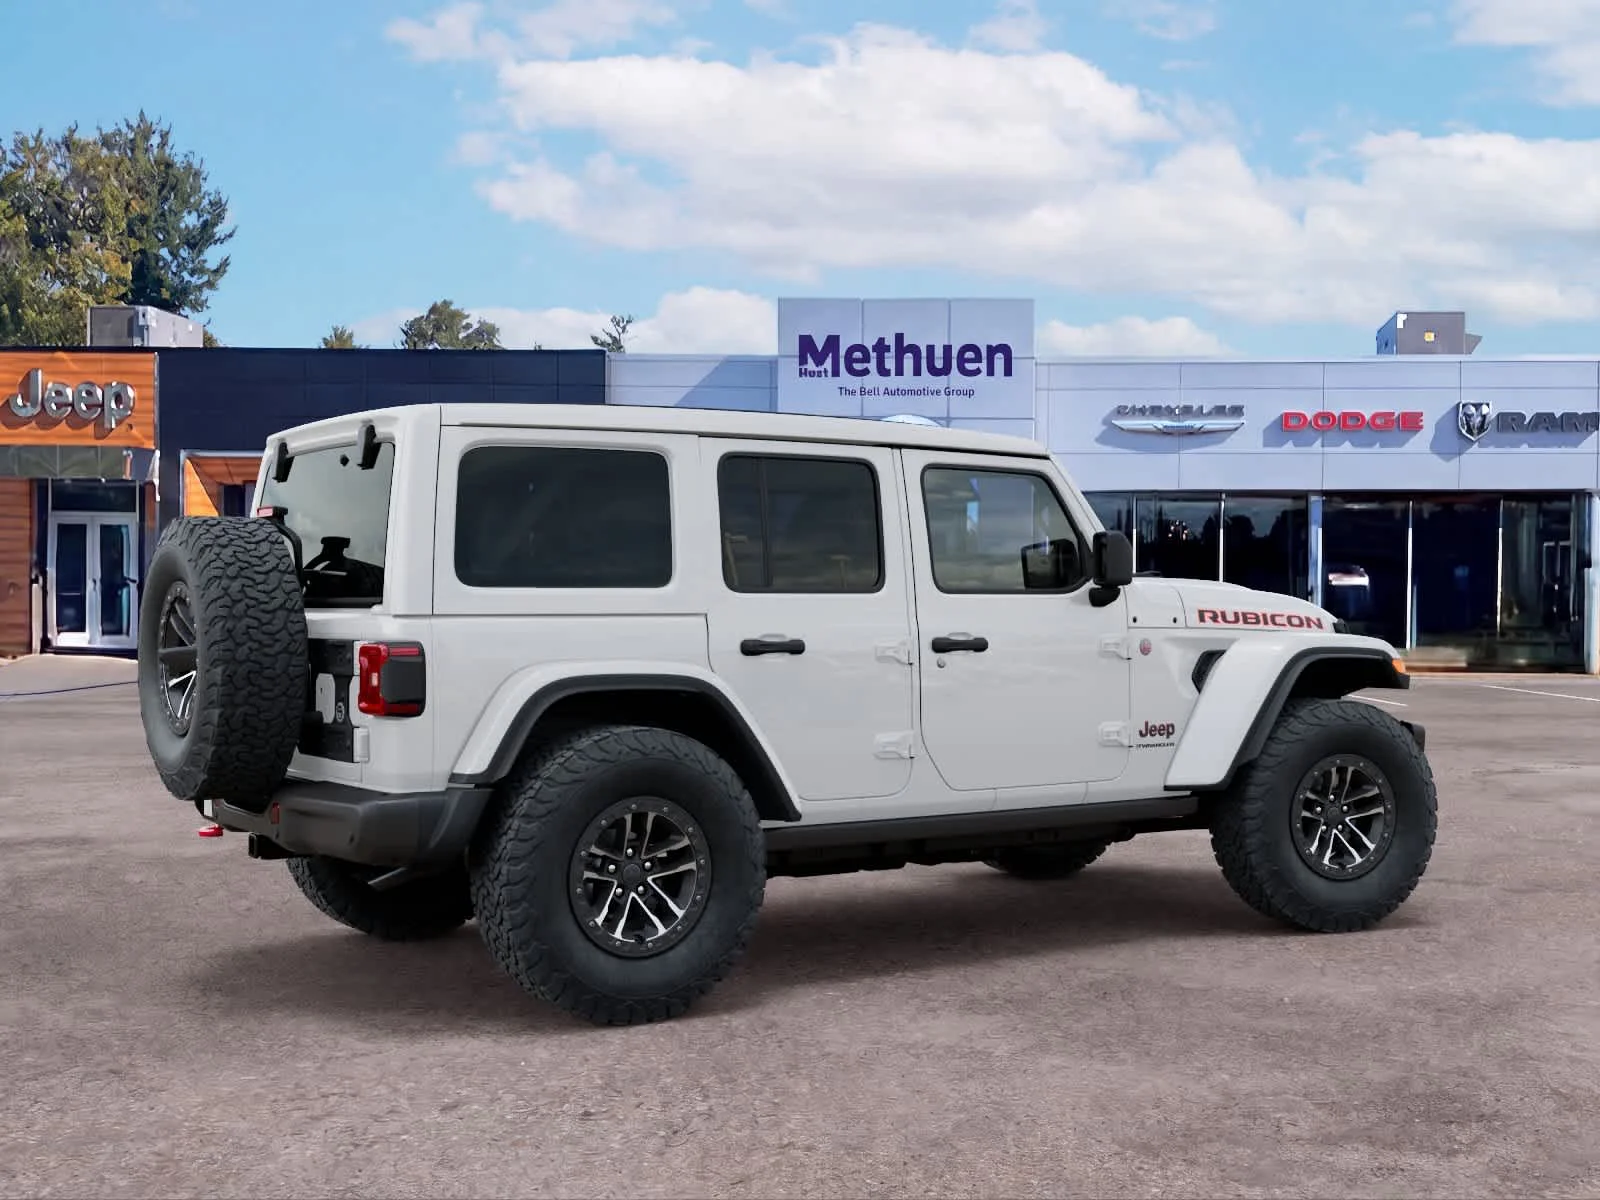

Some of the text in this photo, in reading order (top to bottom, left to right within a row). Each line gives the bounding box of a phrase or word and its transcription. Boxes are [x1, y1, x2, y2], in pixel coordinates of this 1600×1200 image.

[798, 333, 1013, 377] Methuen
[9, 368, 135, 429] Jeep
[838, 386, 975, 398] The Bell Automotive Group
[1282, 411, 1424, 431] DODGE
[1497, 411, 1600, 432] RAM
[1198, 609, 1324, 630] RUBICON
[1138, 719, 1175, 739] Jeep
